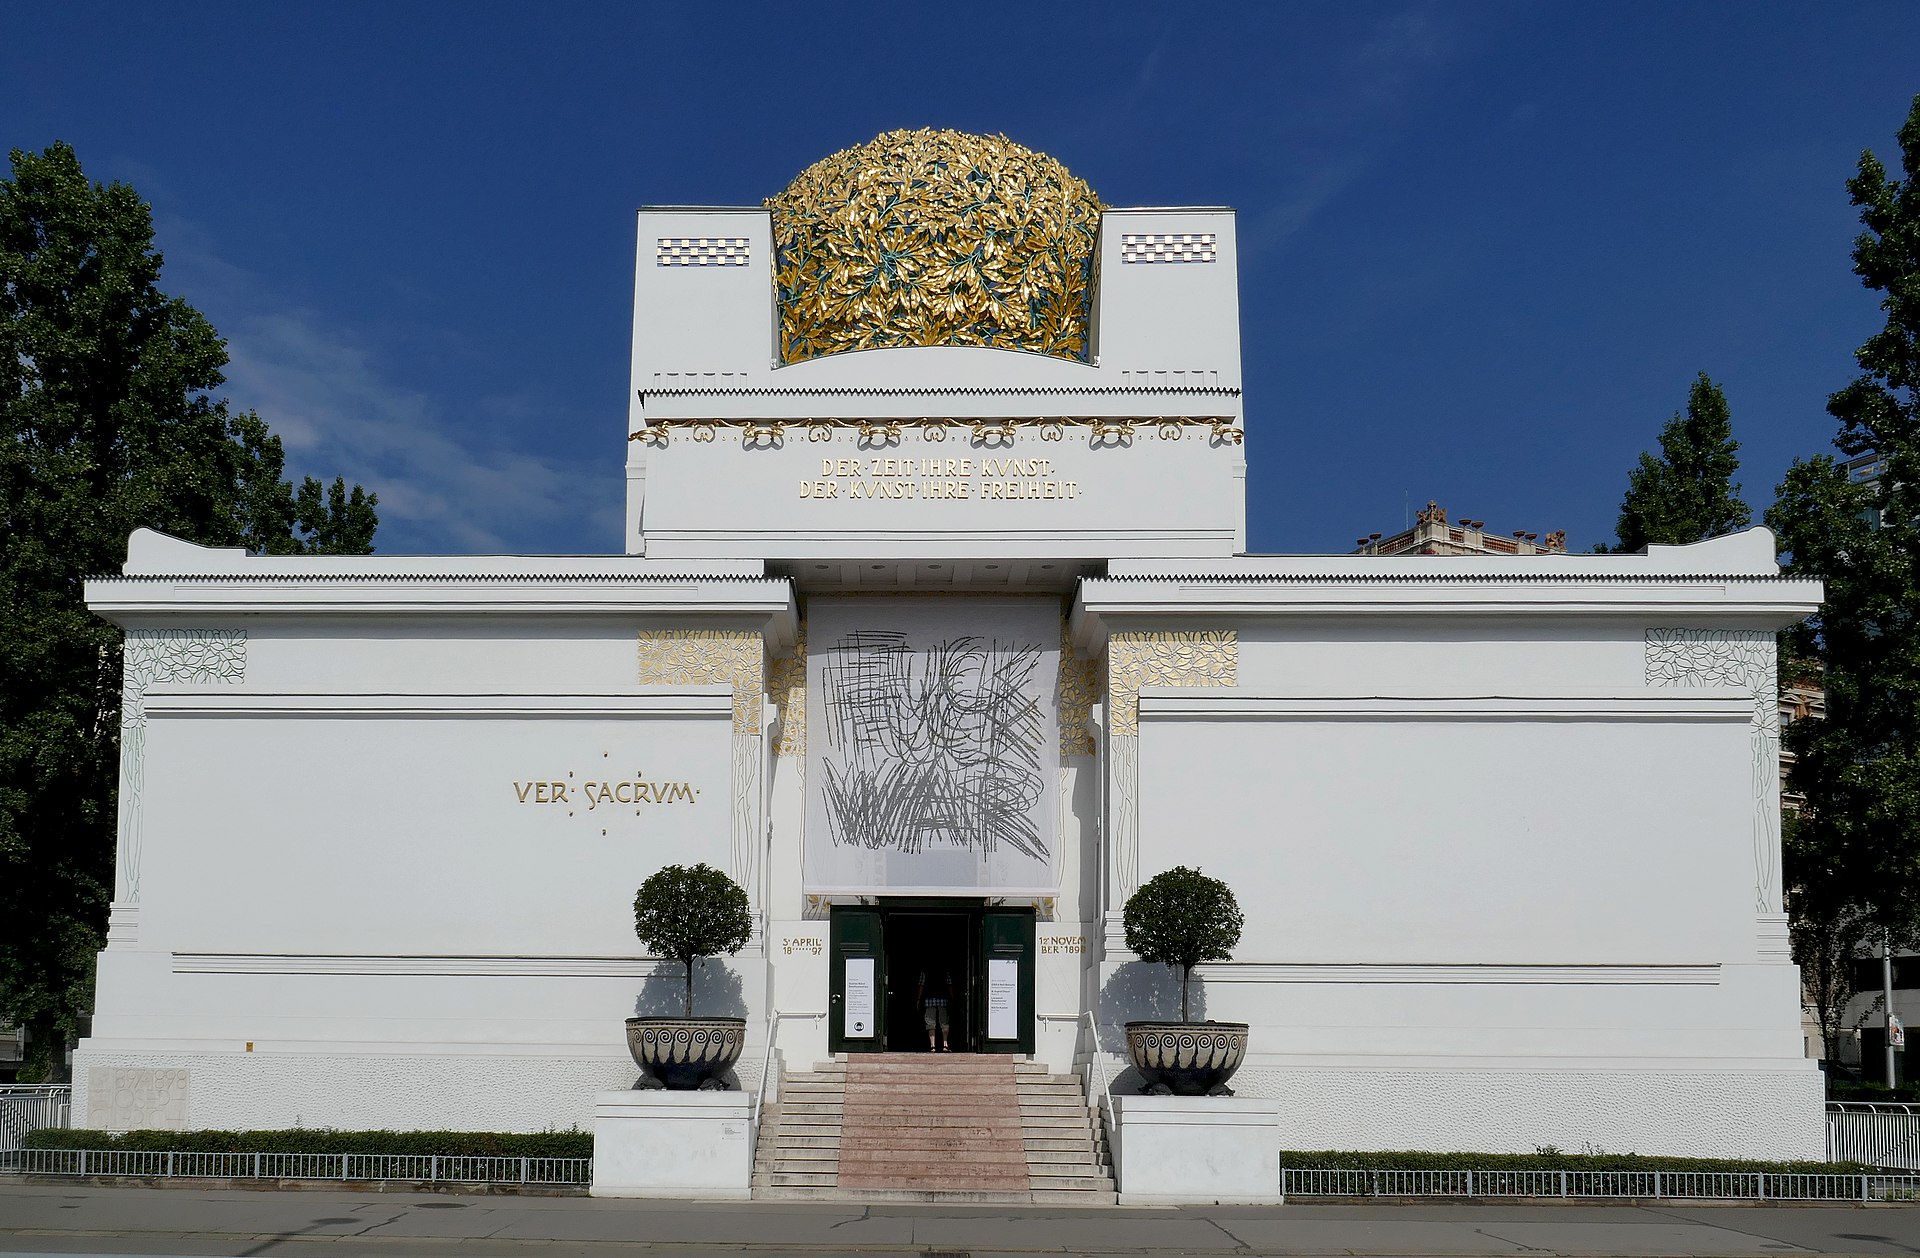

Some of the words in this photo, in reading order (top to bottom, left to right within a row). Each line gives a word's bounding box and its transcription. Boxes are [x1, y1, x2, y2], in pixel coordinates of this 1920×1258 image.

[821, 458, 862, 477] DER
[870, 458, 915, 477] ZEIT
[920, 458, 973, 477] IHRE
[799, 480, 839, 500] DER
[921, 480, 970, 500] IHRE
